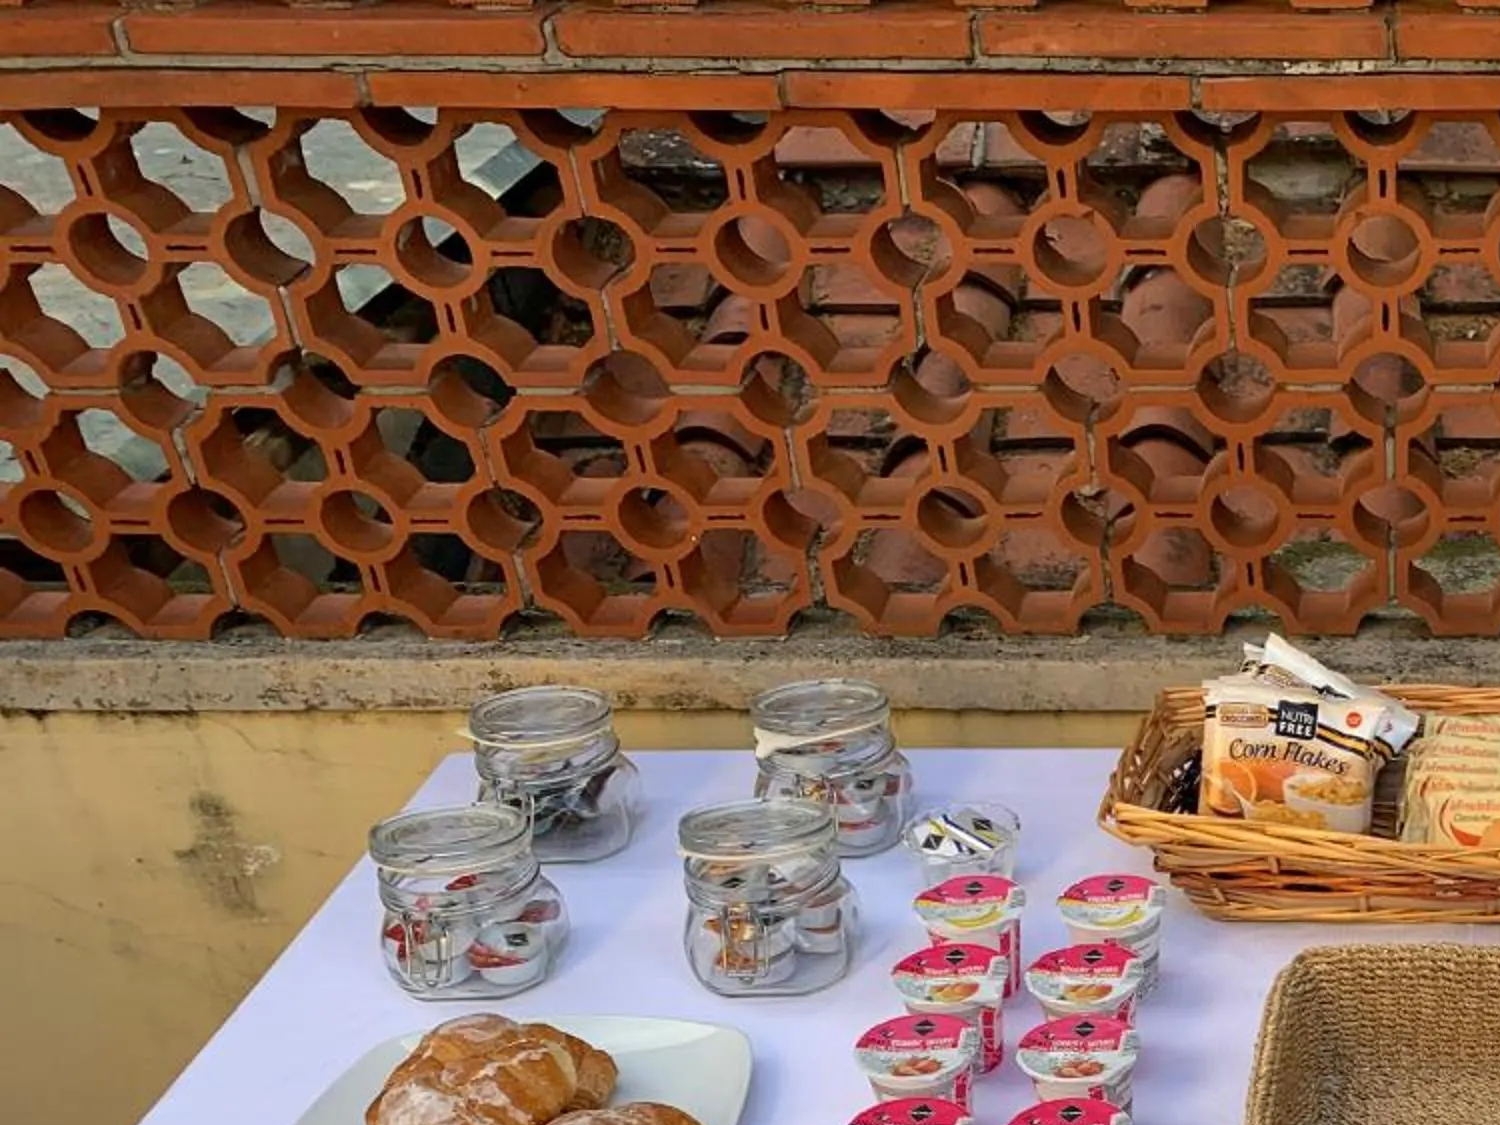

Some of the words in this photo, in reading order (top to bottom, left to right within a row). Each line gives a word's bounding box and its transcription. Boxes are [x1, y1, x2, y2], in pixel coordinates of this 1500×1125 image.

[1279, 710, 1314, 724] NUTRI
[1279, 722, 1313, 736] FREE
[1229, 738, 1277, 760] Corn
[1282, 741, 1350, 775] Flakes
